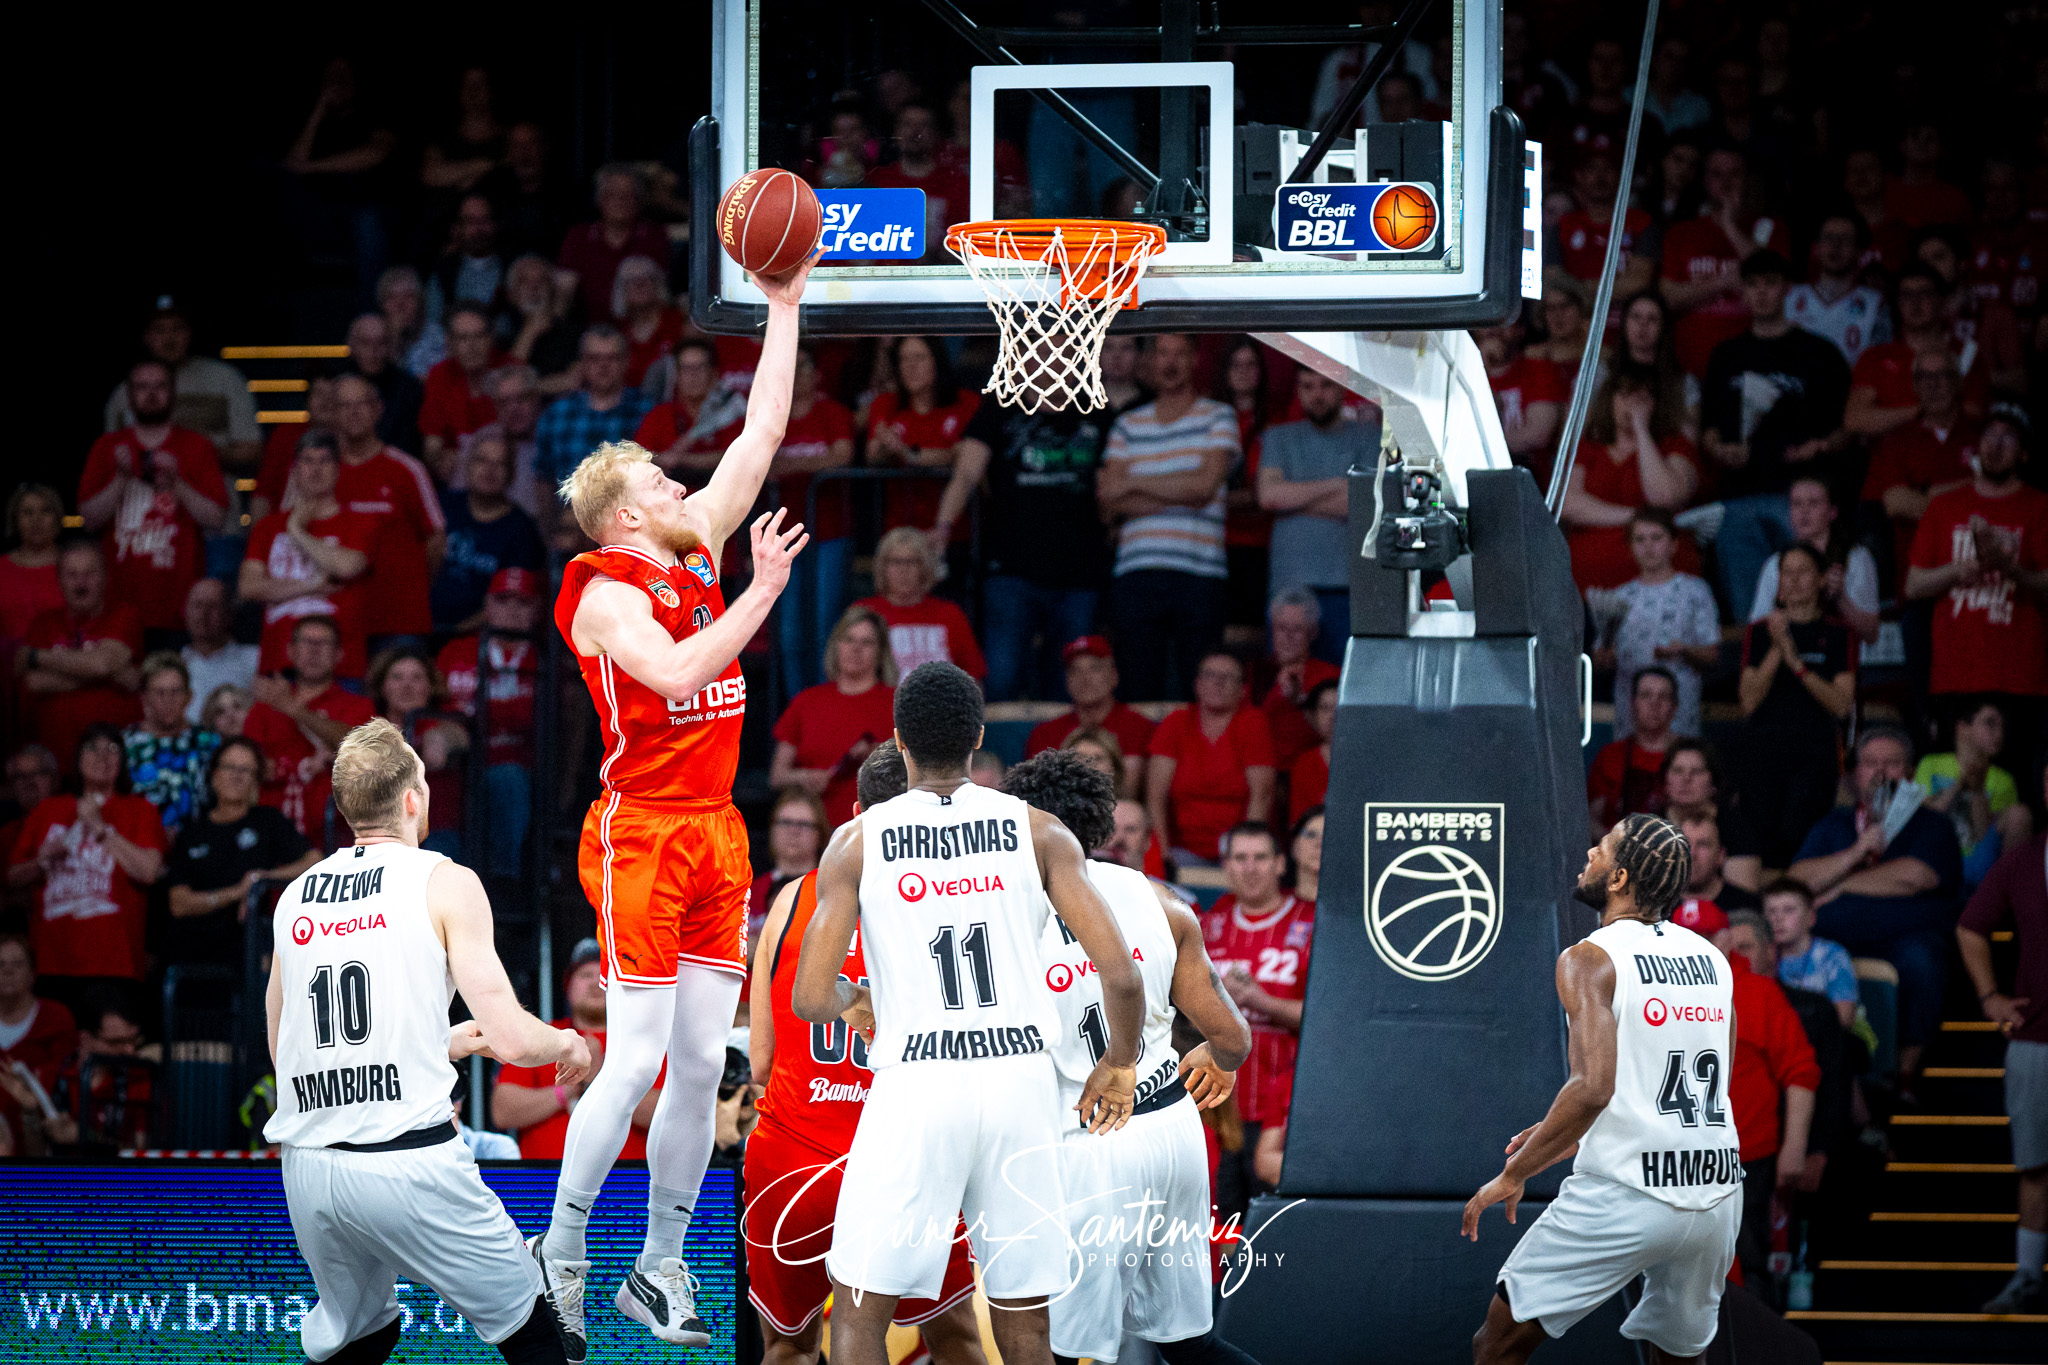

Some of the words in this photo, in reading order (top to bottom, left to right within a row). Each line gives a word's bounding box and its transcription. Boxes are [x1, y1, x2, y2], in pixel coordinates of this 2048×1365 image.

[723, 176, 758, 246] SPALDING
[820, 203, 863, 231] sy
[1308, 204, 1357, 218] Credit
[816, 224, 915, 253] Credit
[1288, 219, 1356, 247] BBL
[669, 713, 704, 726] Technik
[705, 711, 717, 721] für
[1375, 812, 1493, 829] BAMBERG
[1375, 829, 1493, 842] BASKETS
[881, 818, 1018, 862] CHRISTMAS
[300, 865, 385, 904] DZIEWA
[931, 875, 1005, 896] VEOLIA
[319, 913, 387, 937] VEOLIA
[928, 921, 998, 1010] 11
[1255, 946, 1299, 986] 22
[1633, 954, 1718, 986] DURHAM
[308, 960, 372, 1050] 10
[1671, 1006, 1725, 1024] VEOLIA
[901, 1024, 1043, 1063] HAMBURG
[291, 1063, 402, 1114] HAMBURG
[1656, 1049, 1727, 1128] 42
